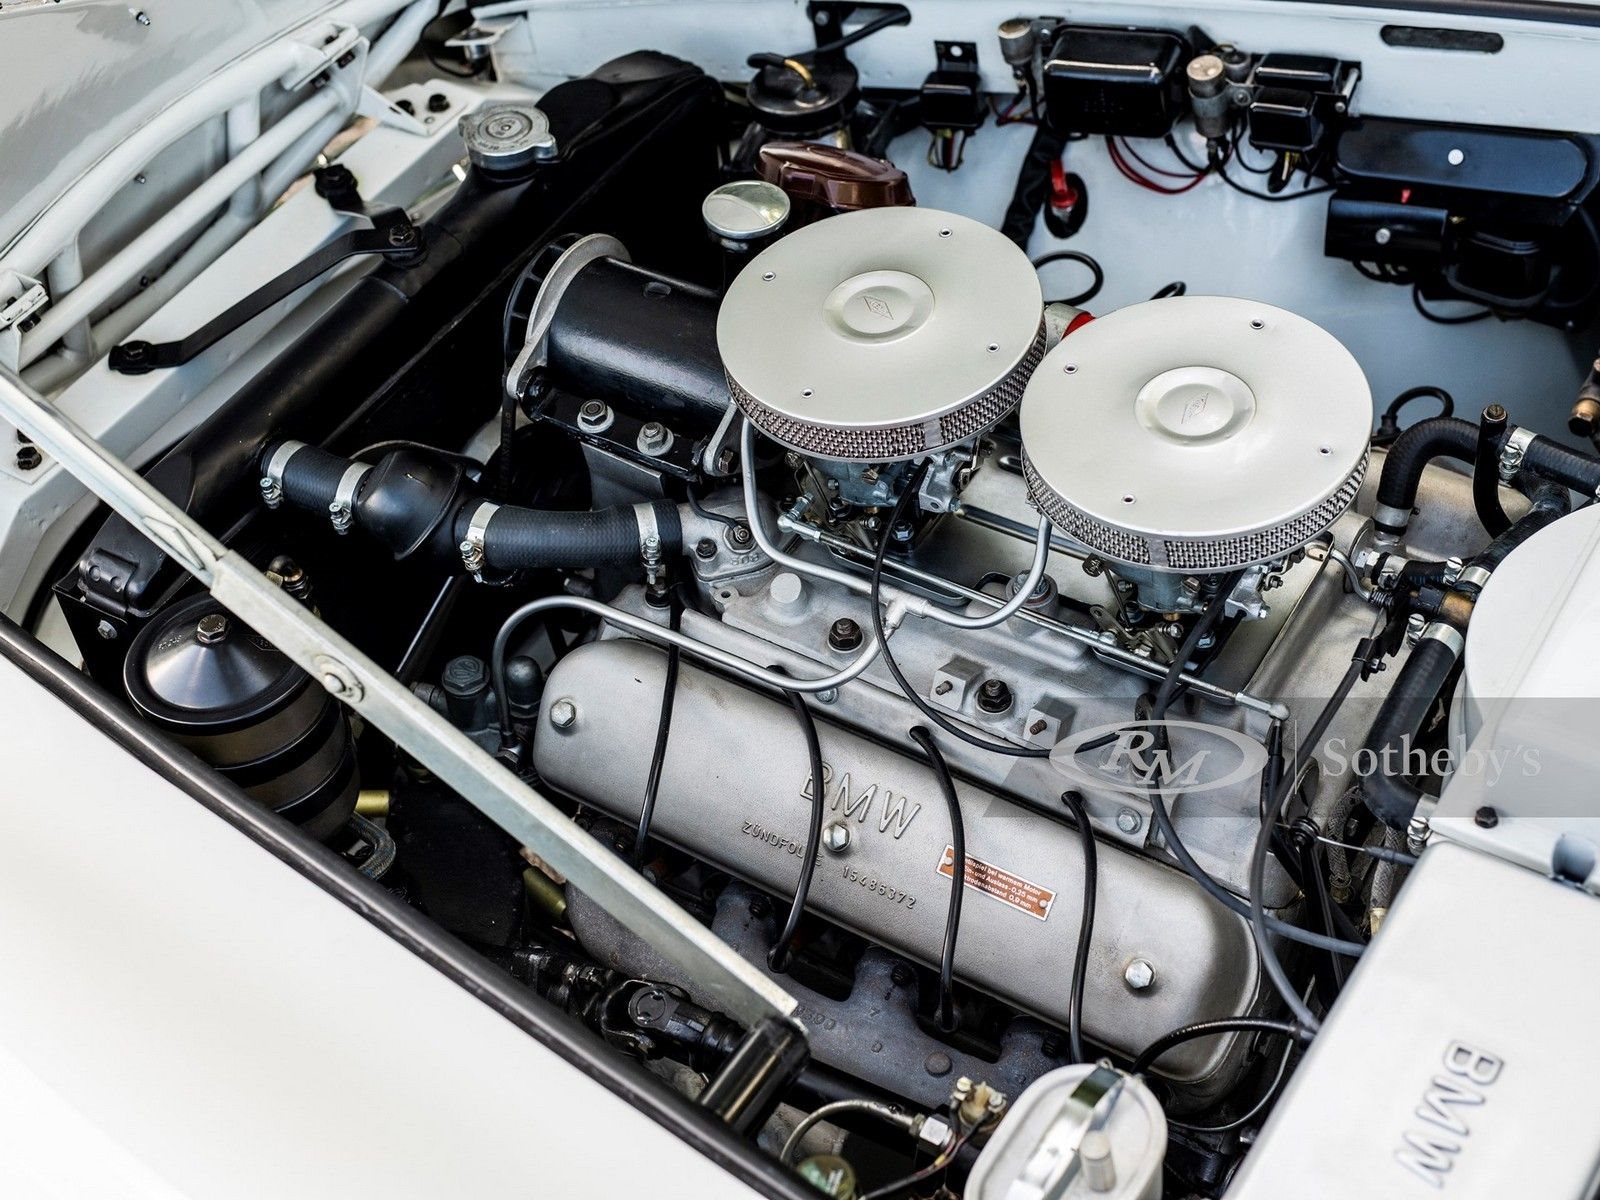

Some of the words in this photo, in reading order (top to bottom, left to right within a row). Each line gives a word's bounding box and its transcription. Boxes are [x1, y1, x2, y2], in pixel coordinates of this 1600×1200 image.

[742, 820, 823, 866] ZÜNDFOLE
[843, 866, 917, 909] 15486372
[1393, 1039, 1505, 1189] BMW
